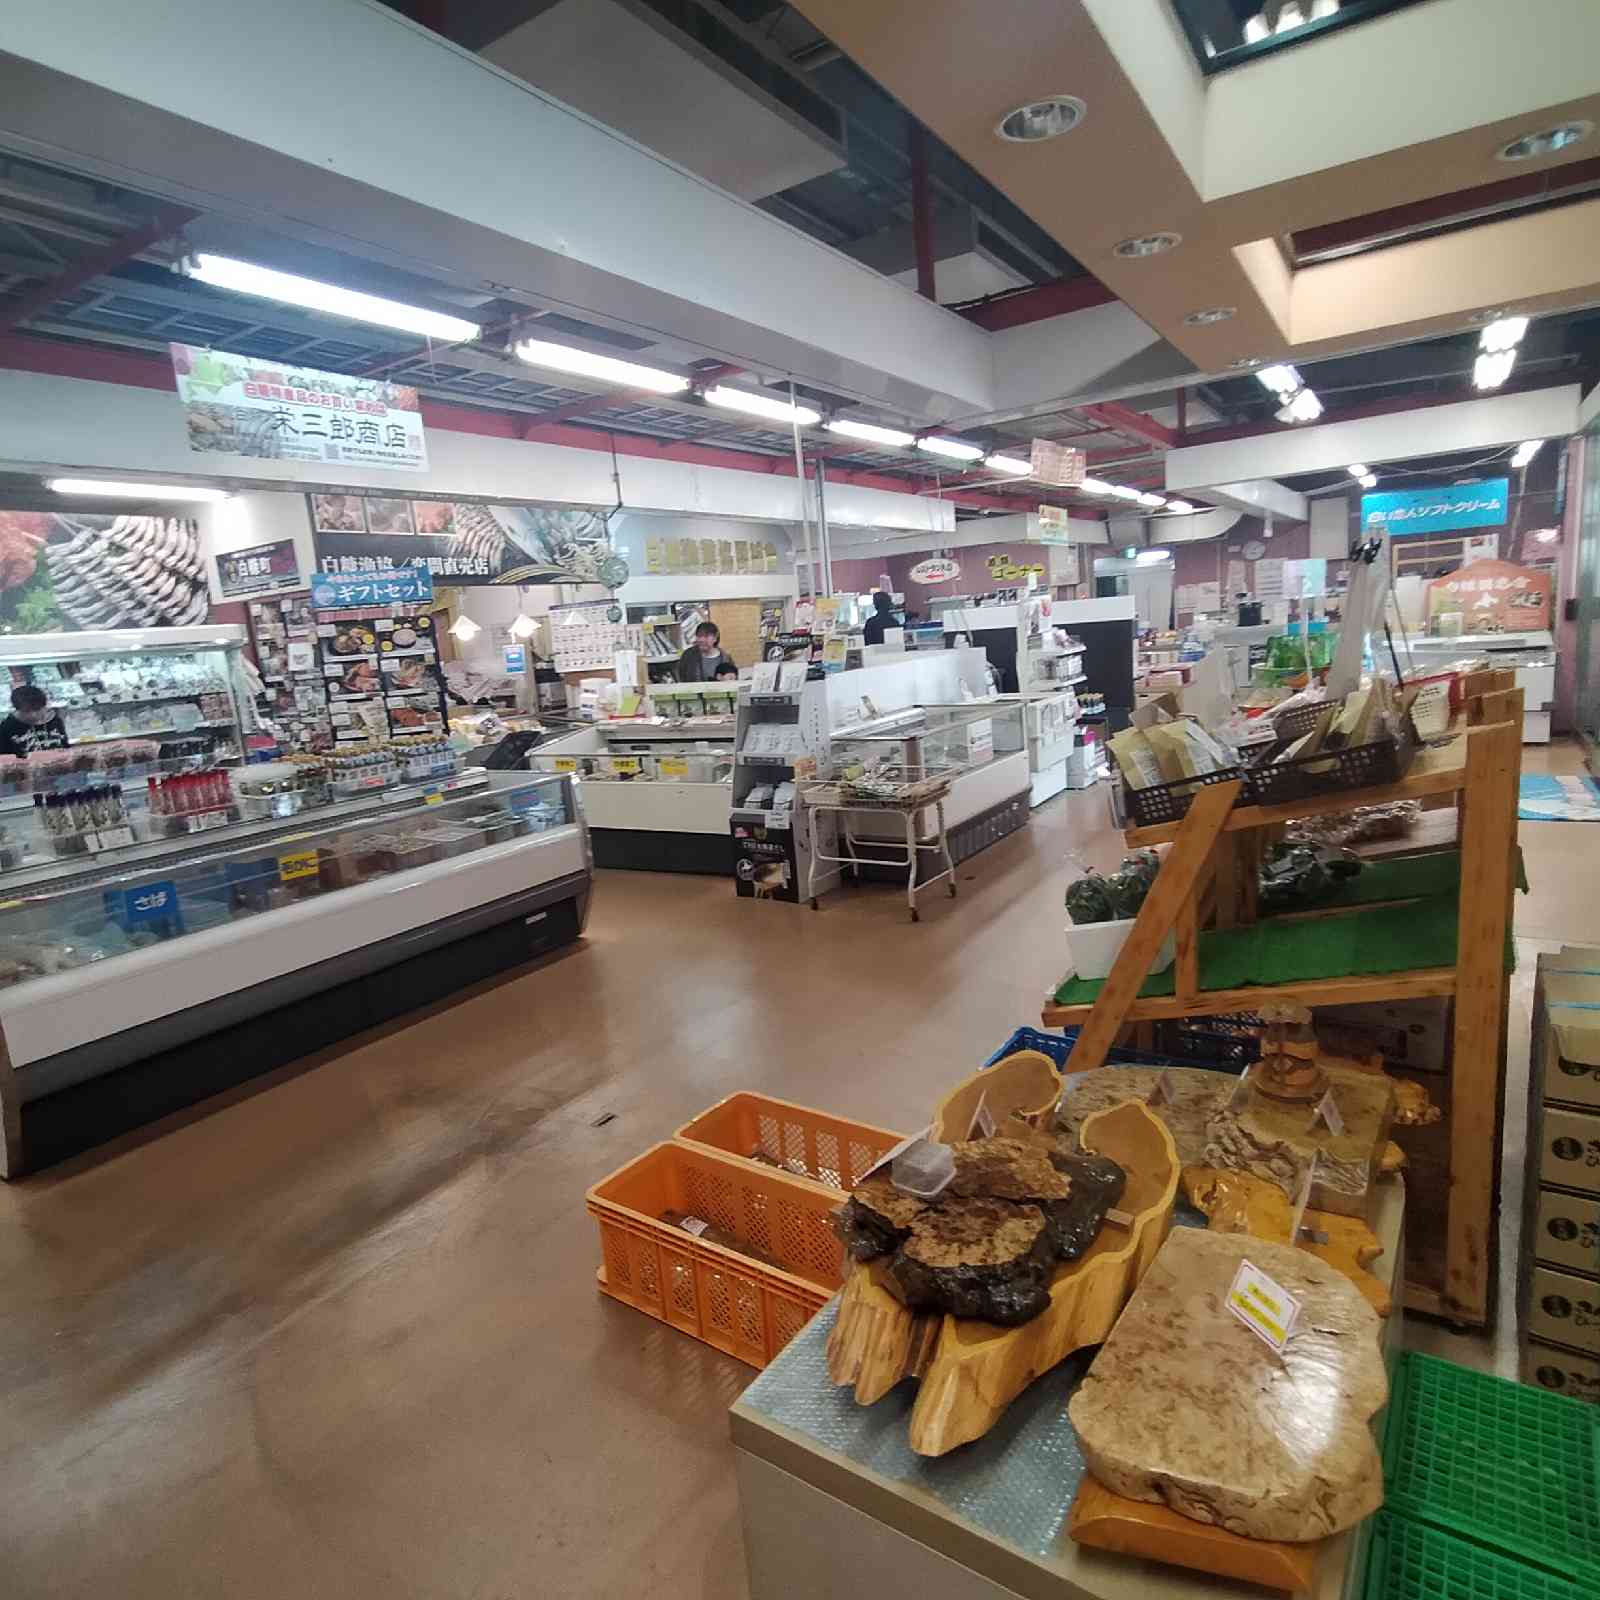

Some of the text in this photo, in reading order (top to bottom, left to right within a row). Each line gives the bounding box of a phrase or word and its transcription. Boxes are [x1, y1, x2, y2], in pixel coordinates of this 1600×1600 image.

[272, 406, 406, 449] 栄三郎商店
[338, 580, 429, 602] ギフトセット
